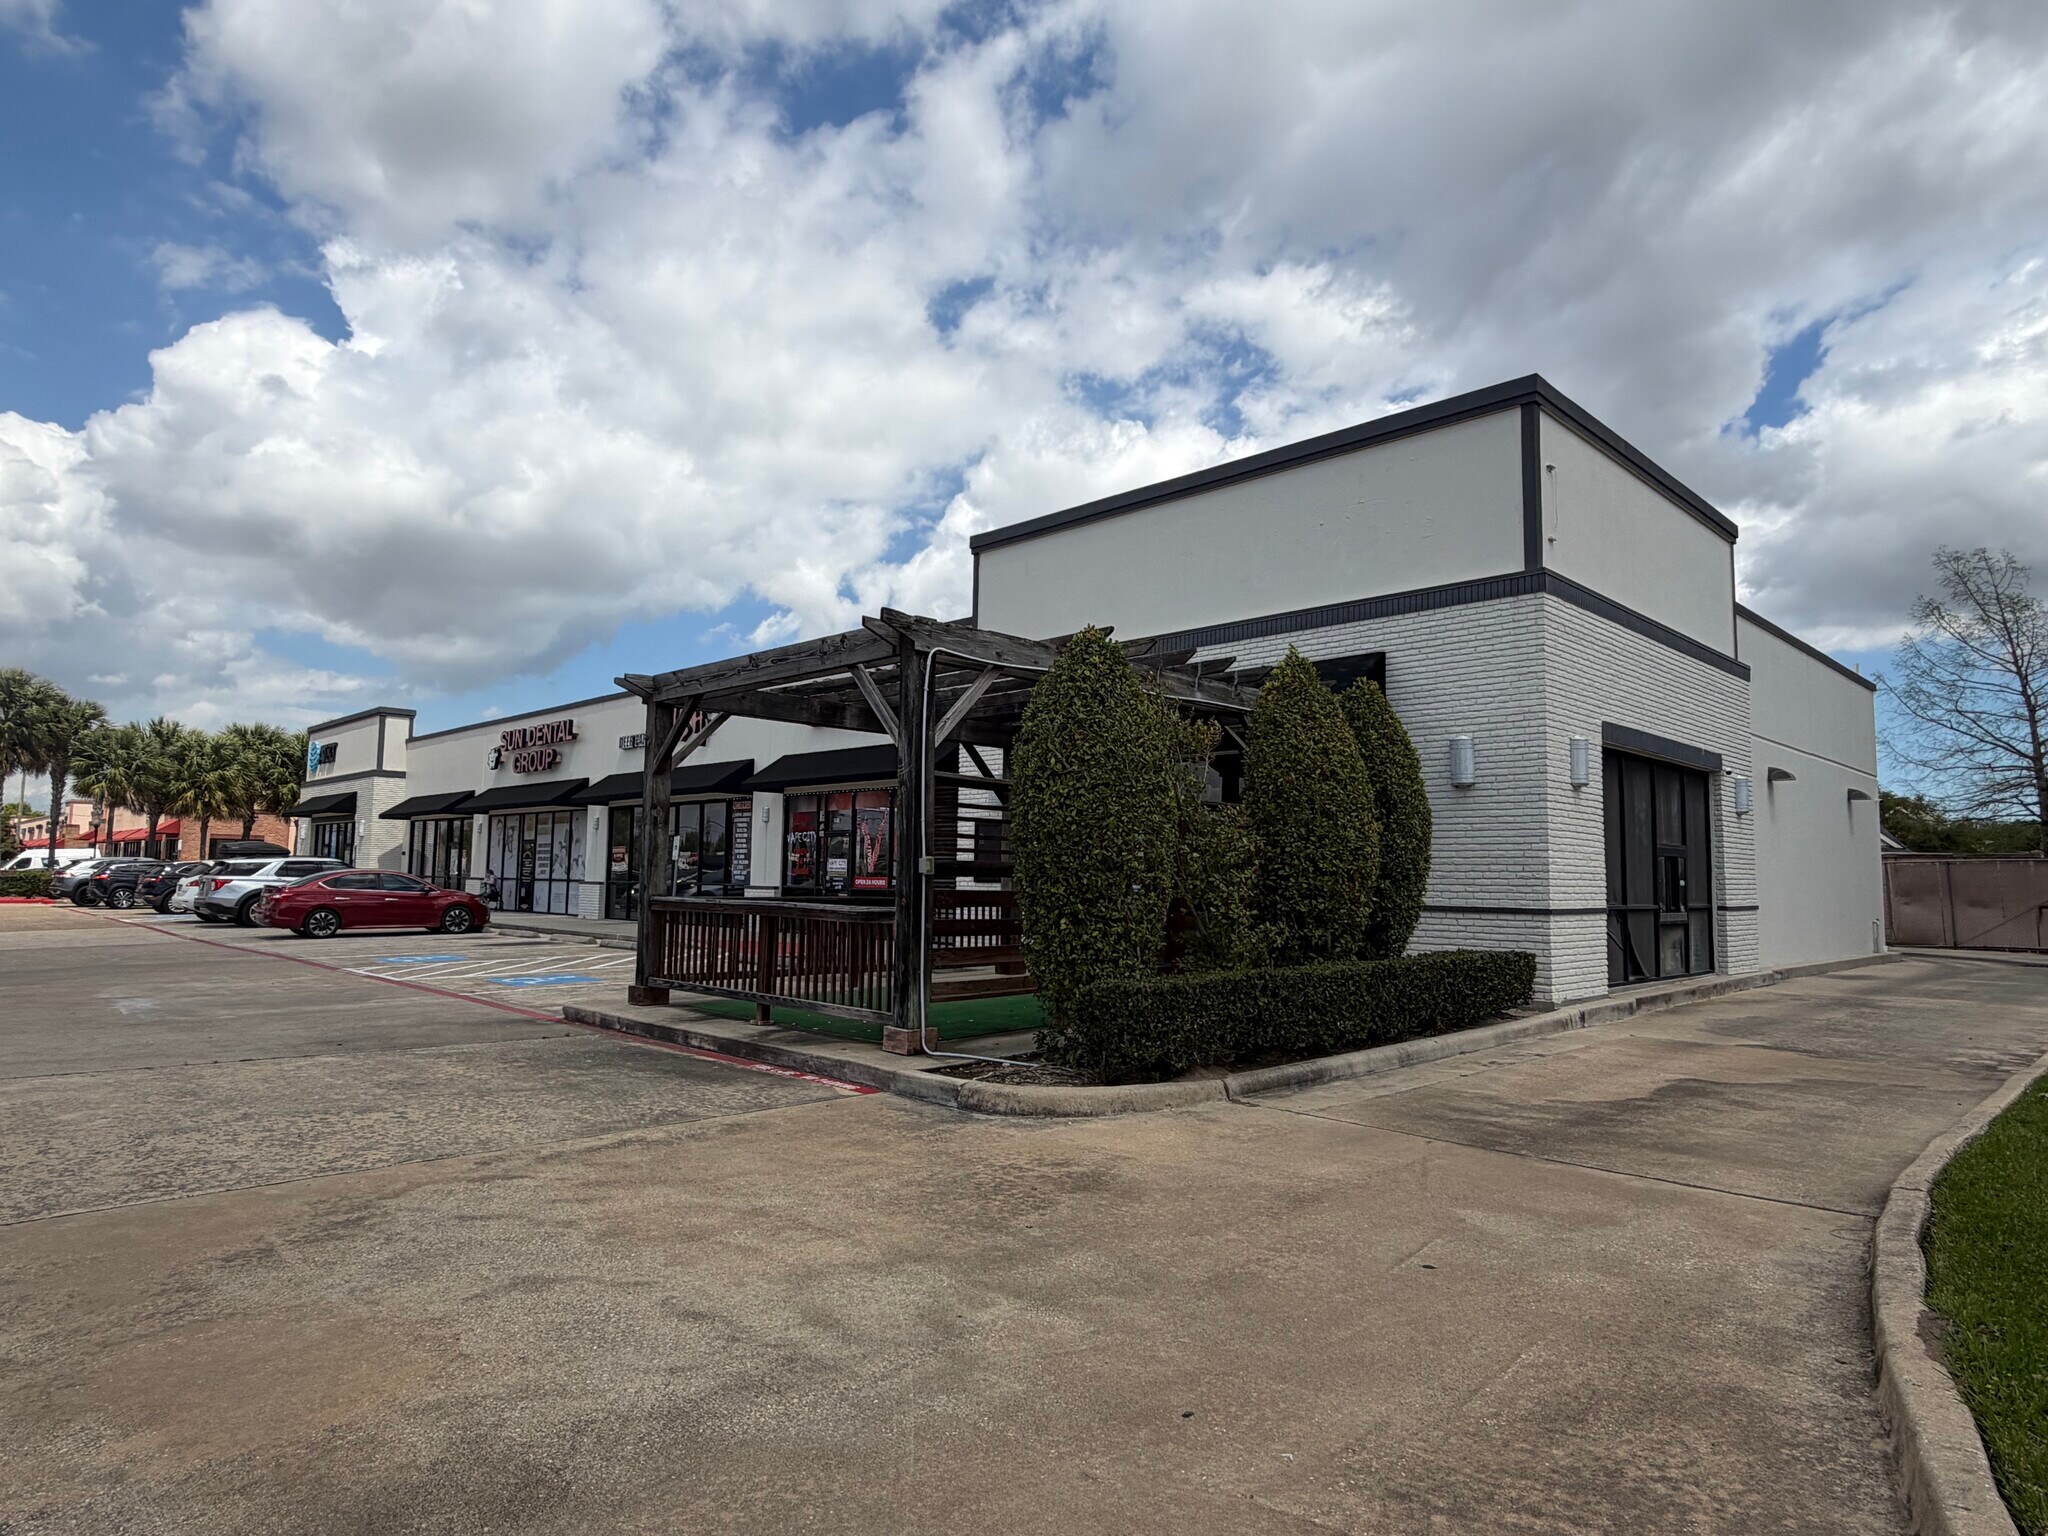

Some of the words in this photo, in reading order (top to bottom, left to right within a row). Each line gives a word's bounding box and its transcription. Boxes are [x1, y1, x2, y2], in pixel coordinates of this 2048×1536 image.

[500, 728, 526, 752] SUN
[527, 719, 574, 747] DENTAL
[513, 748, 557, 774] GROUP
